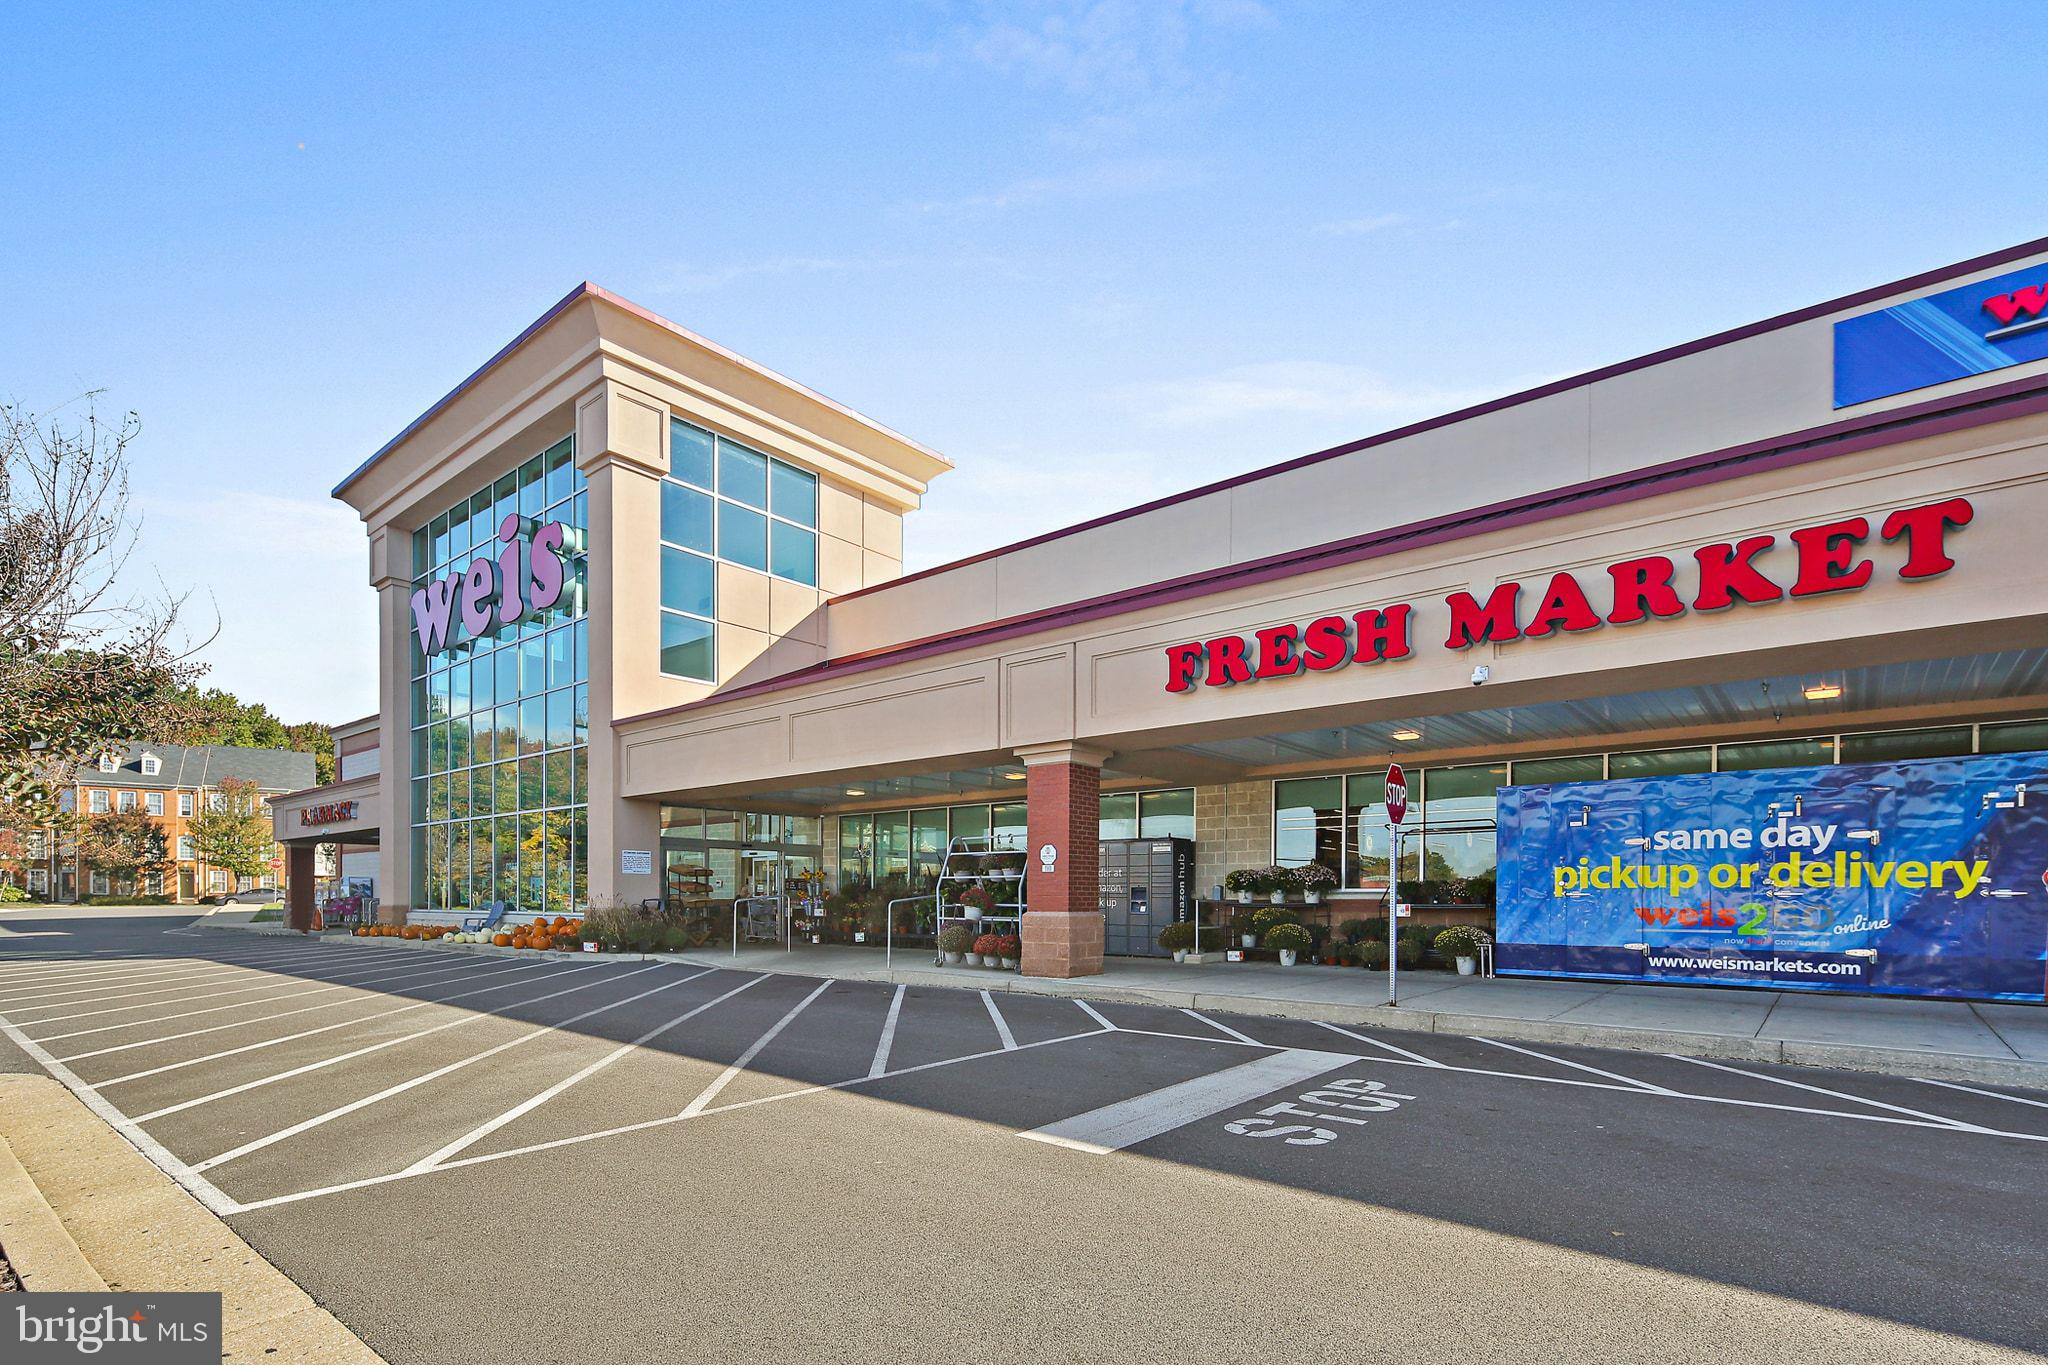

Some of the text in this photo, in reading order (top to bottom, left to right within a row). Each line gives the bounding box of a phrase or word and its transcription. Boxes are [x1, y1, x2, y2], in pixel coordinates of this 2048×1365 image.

[411, 513, 568, 656] weis
[1165, 497, 1975, 694] FRESH MARKET
[1387, 782, 1406, 807] STOP
[300, 800, 353, 827] PHARMACY
[1653, 817, 1838, 855] same day
[1177, 853, 1185, 878] hub
[1554, 850, 1988, 899] pickup or delivery
[1833, 914, 1892, 936] online
[1648, 956, 1862, 976] www.weismarkets.com
[1223, 1078, 1417, 1146] STOP
